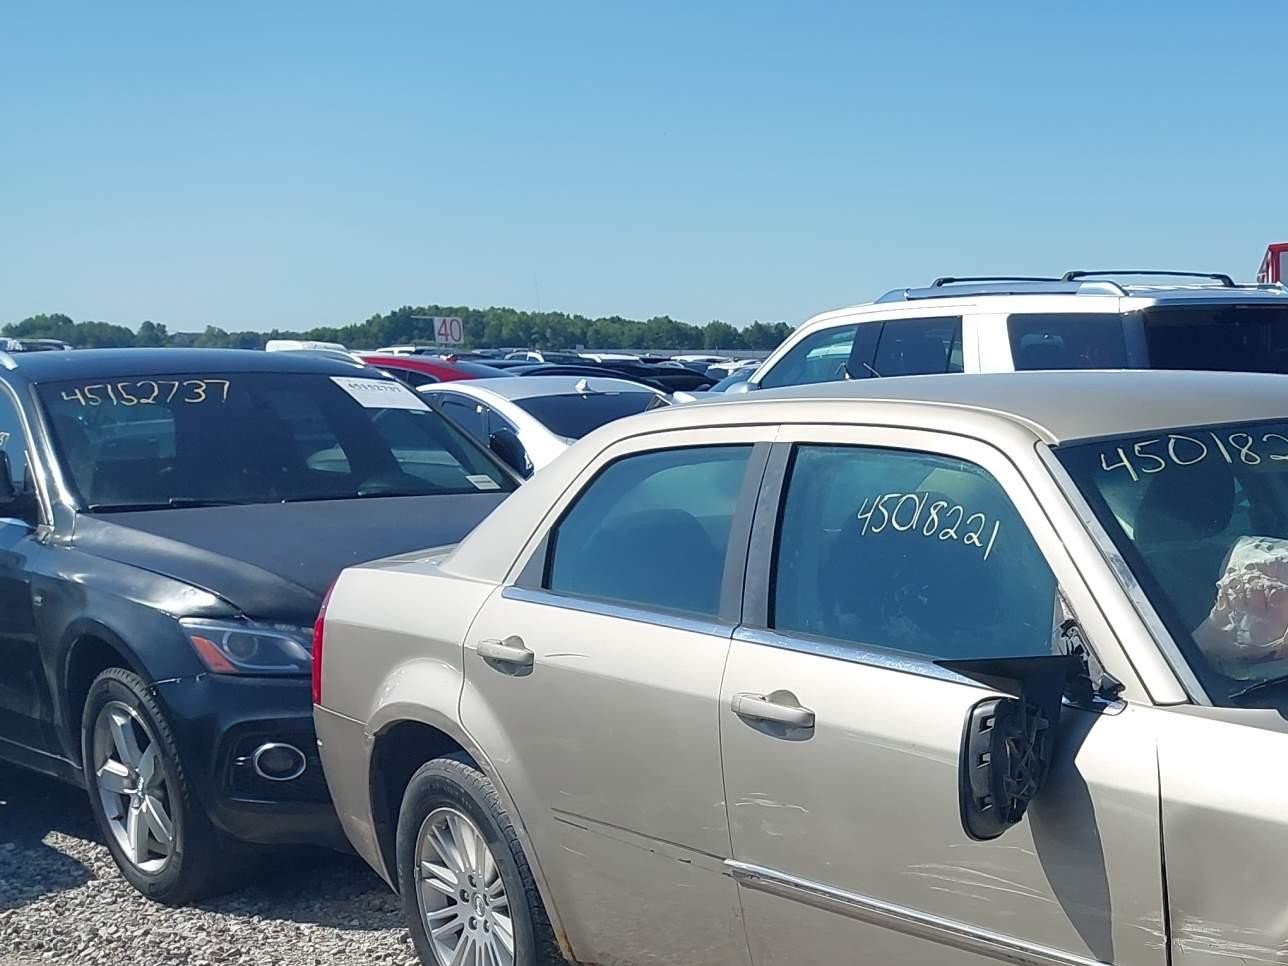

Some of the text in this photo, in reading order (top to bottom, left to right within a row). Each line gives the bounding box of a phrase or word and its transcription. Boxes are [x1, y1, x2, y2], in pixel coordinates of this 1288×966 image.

[437, 318, 462, 342] 40
[60, 379, 231, 407] 45152737
[857, 491, 1000, 561] 45018221
